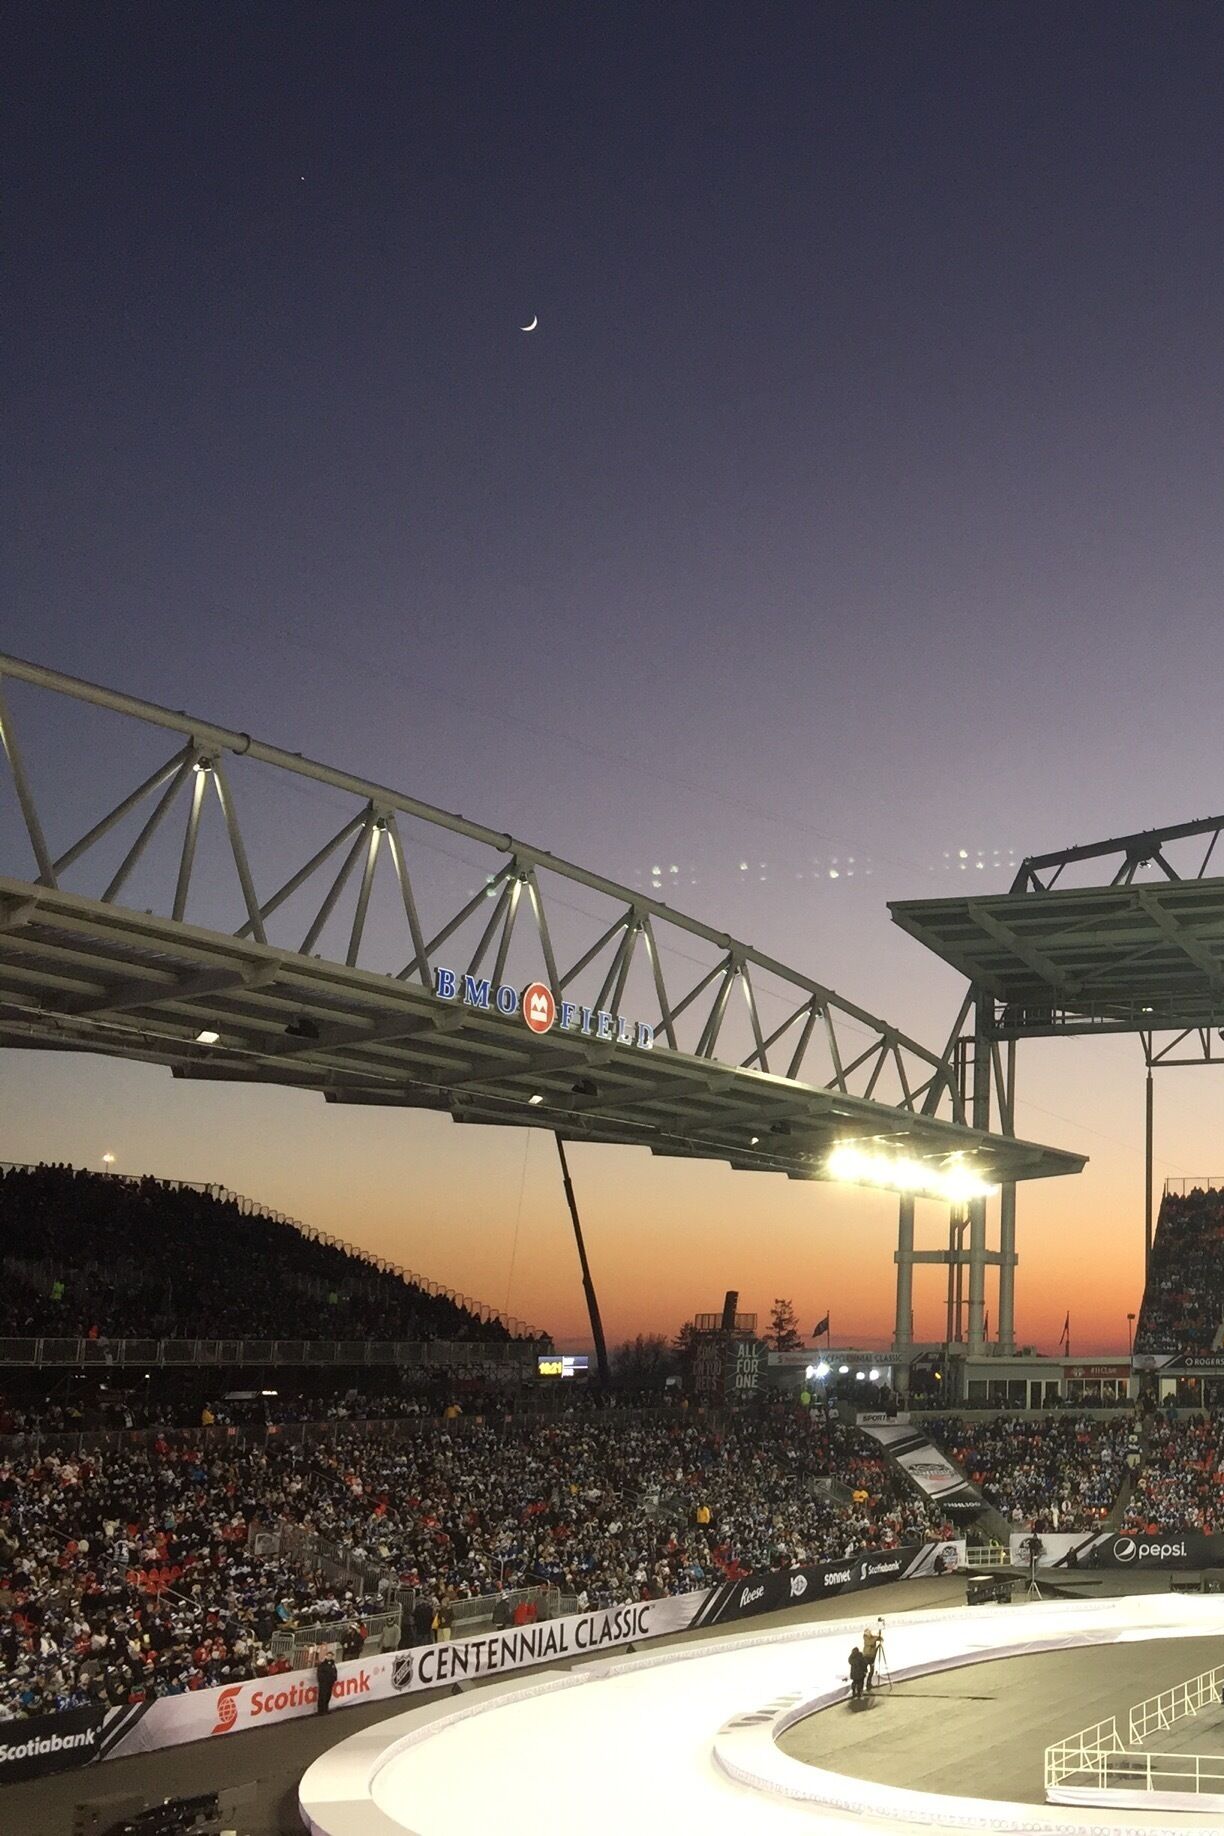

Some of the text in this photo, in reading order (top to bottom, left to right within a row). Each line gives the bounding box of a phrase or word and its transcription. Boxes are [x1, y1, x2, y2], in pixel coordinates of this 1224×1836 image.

[437, 967, 654, 1049] BMO FIELD
[738, 1343, 759, 1358] ALL
[736, 1359, 759, 1373] FOR
[1194, 1358, 1224, 1366] ROGERS
[735, 1374, 759, 1388] ONE
[868, 1560, 900, 1575] Scotiabank
[824, 1569, 851, 1586] sonnet
[418, 1623, 569, 1684] CENTENNIAL
[575, 1604, 651, 1649] CLASSIC
[250, 1670, 370, 1716] Scotiaank
[0, 1727, 96, 1763] Scotiabank
